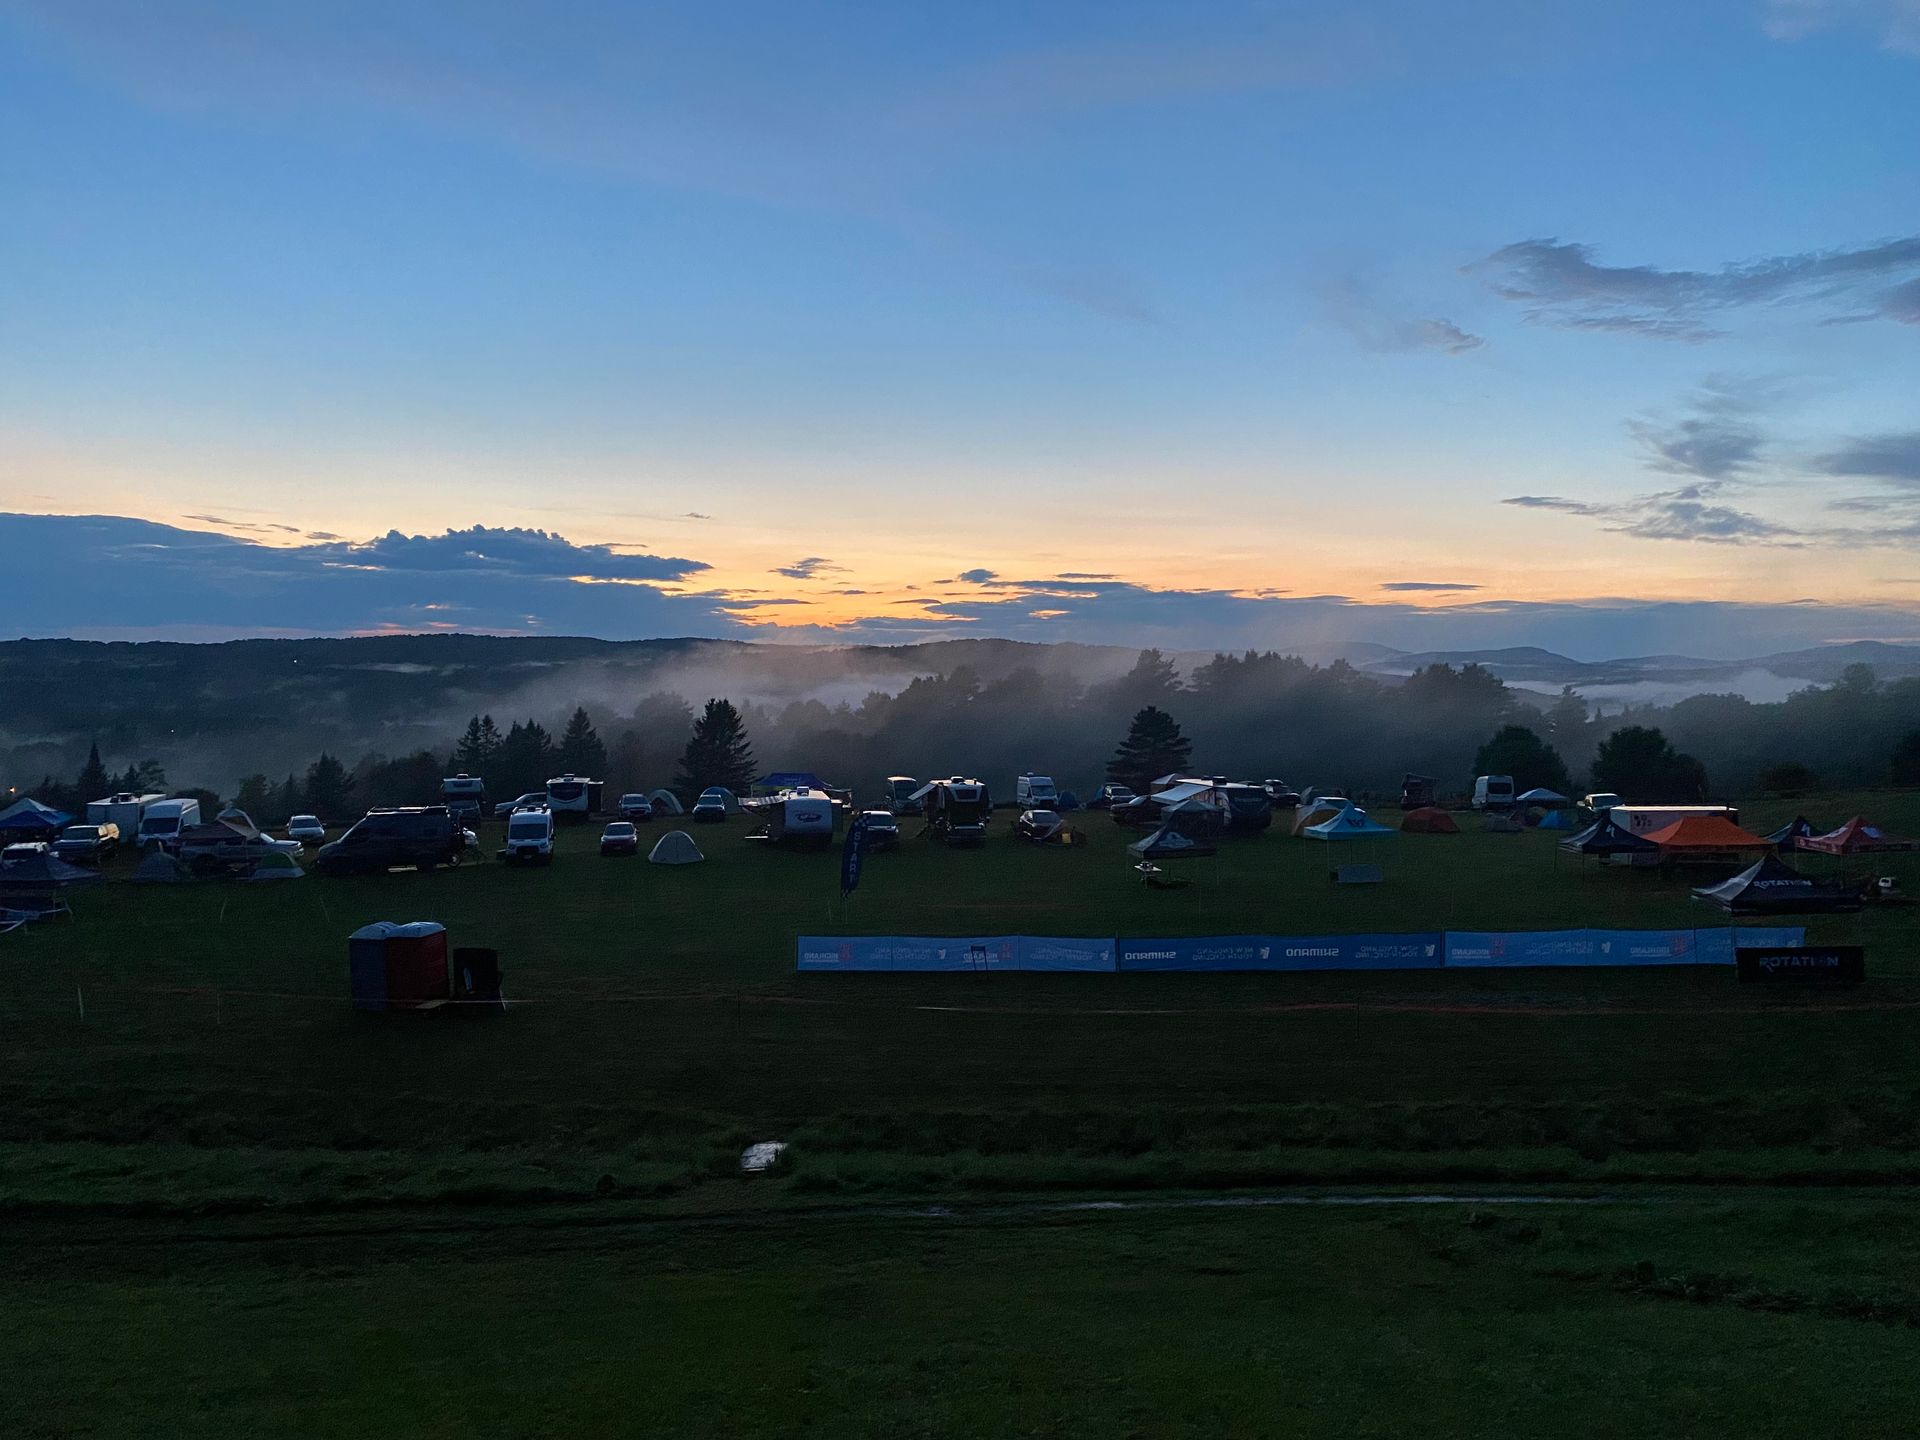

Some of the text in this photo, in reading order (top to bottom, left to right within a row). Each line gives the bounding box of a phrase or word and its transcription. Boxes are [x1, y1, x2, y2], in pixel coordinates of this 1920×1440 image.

[848, 831, 862, 884] START
[1752, 879, 1813, 889] ROTATIN
[1759, 956, 1840, 973] ROTATIN
